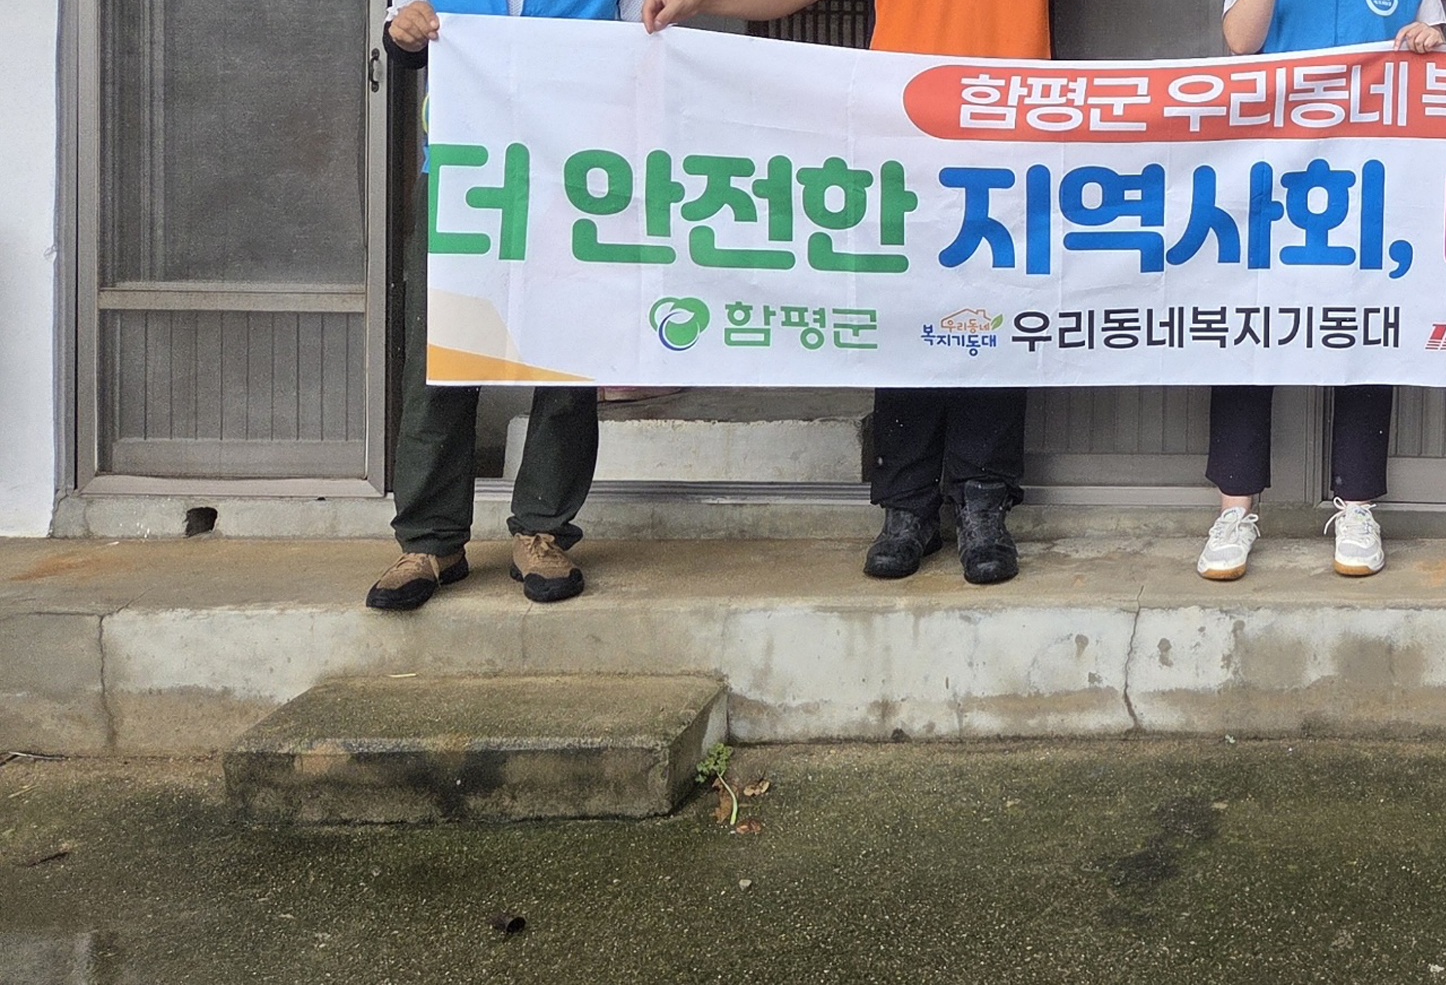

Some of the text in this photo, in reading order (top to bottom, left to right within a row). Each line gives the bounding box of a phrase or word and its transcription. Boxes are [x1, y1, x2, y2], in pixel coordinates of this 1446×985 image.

[960, 72, 1151, 132] 함평군
[1164, 63, 1409, 133] 우리동네
[427, 143, 528, 260] 더
[564, 151, 918, 272] 안전한
[939, 159, 1413, 279] 지역사회,
[724, 302, 878, 350] 함평군
[921, 324, 997, 357] 복지기동대
[945, 319, 990, 333] 우리동네
[1011, 307, 1400, 351] 우리동네복지기동대
